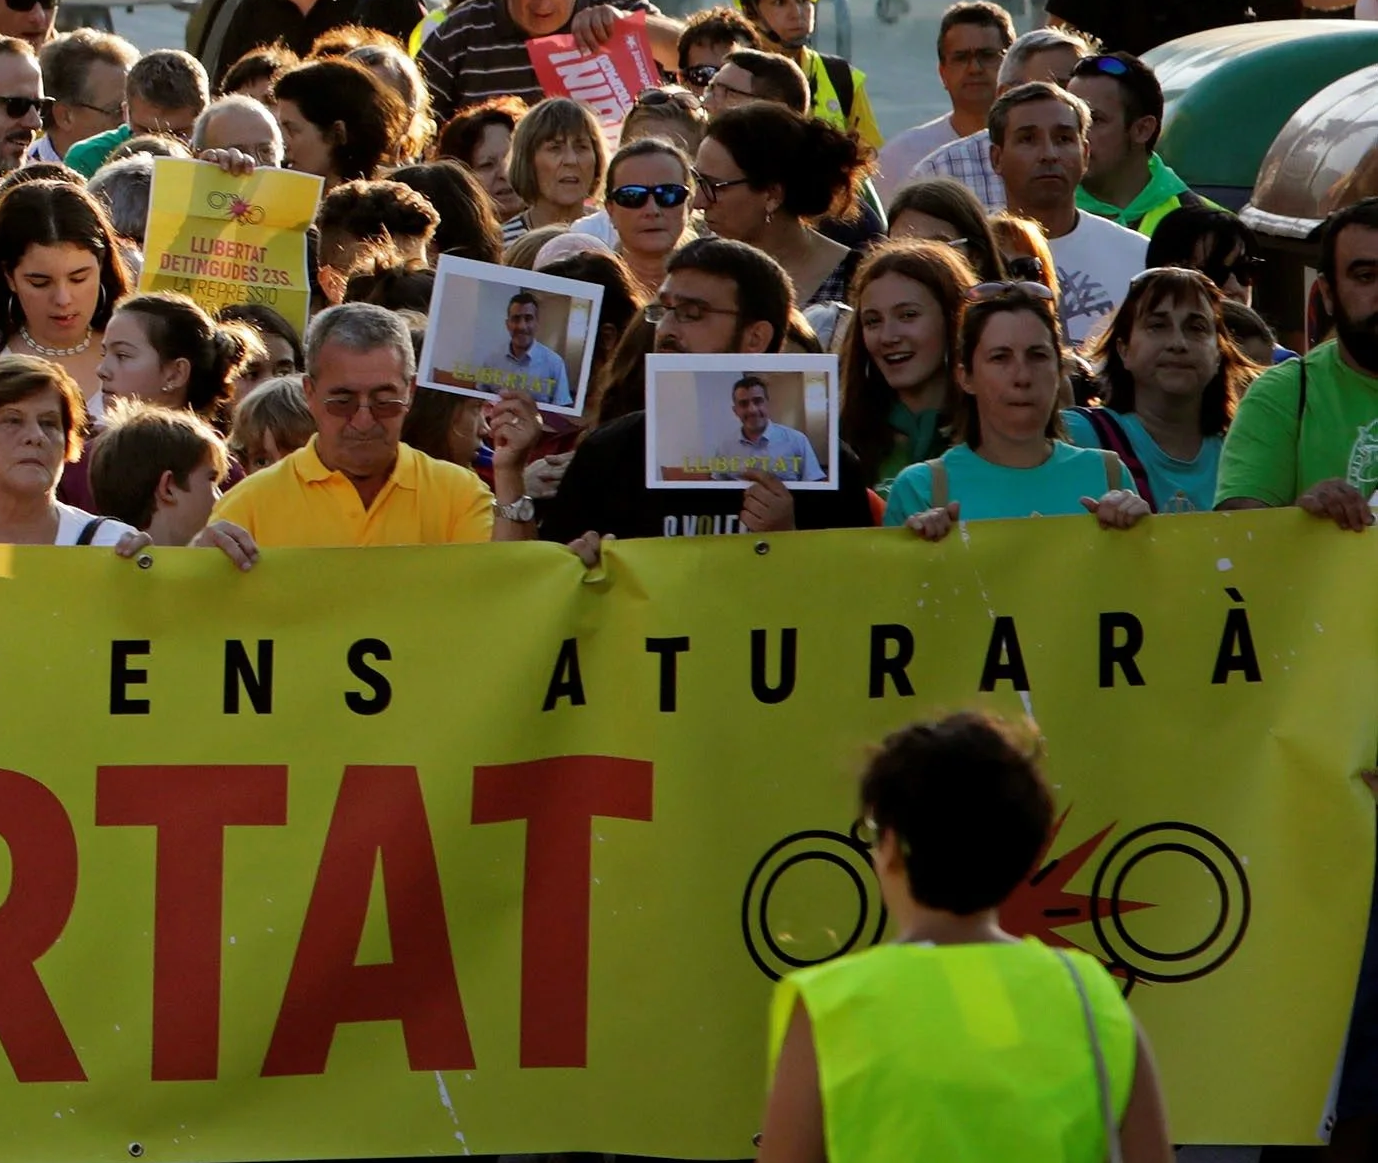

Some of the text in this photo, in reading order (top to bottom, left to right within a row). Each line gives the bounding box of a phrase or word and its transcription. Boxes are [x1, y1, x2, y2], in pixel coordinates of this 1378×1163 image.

[190, 236, 268, 264] LLIBERTAT
[160, 253, 258, 283] DETINGUDES
[682, 454, 803, 475] LLIBERTAT
[110, 637, 393, 717] ENS
[542, 586, 1263, 713] ATURARÀ
